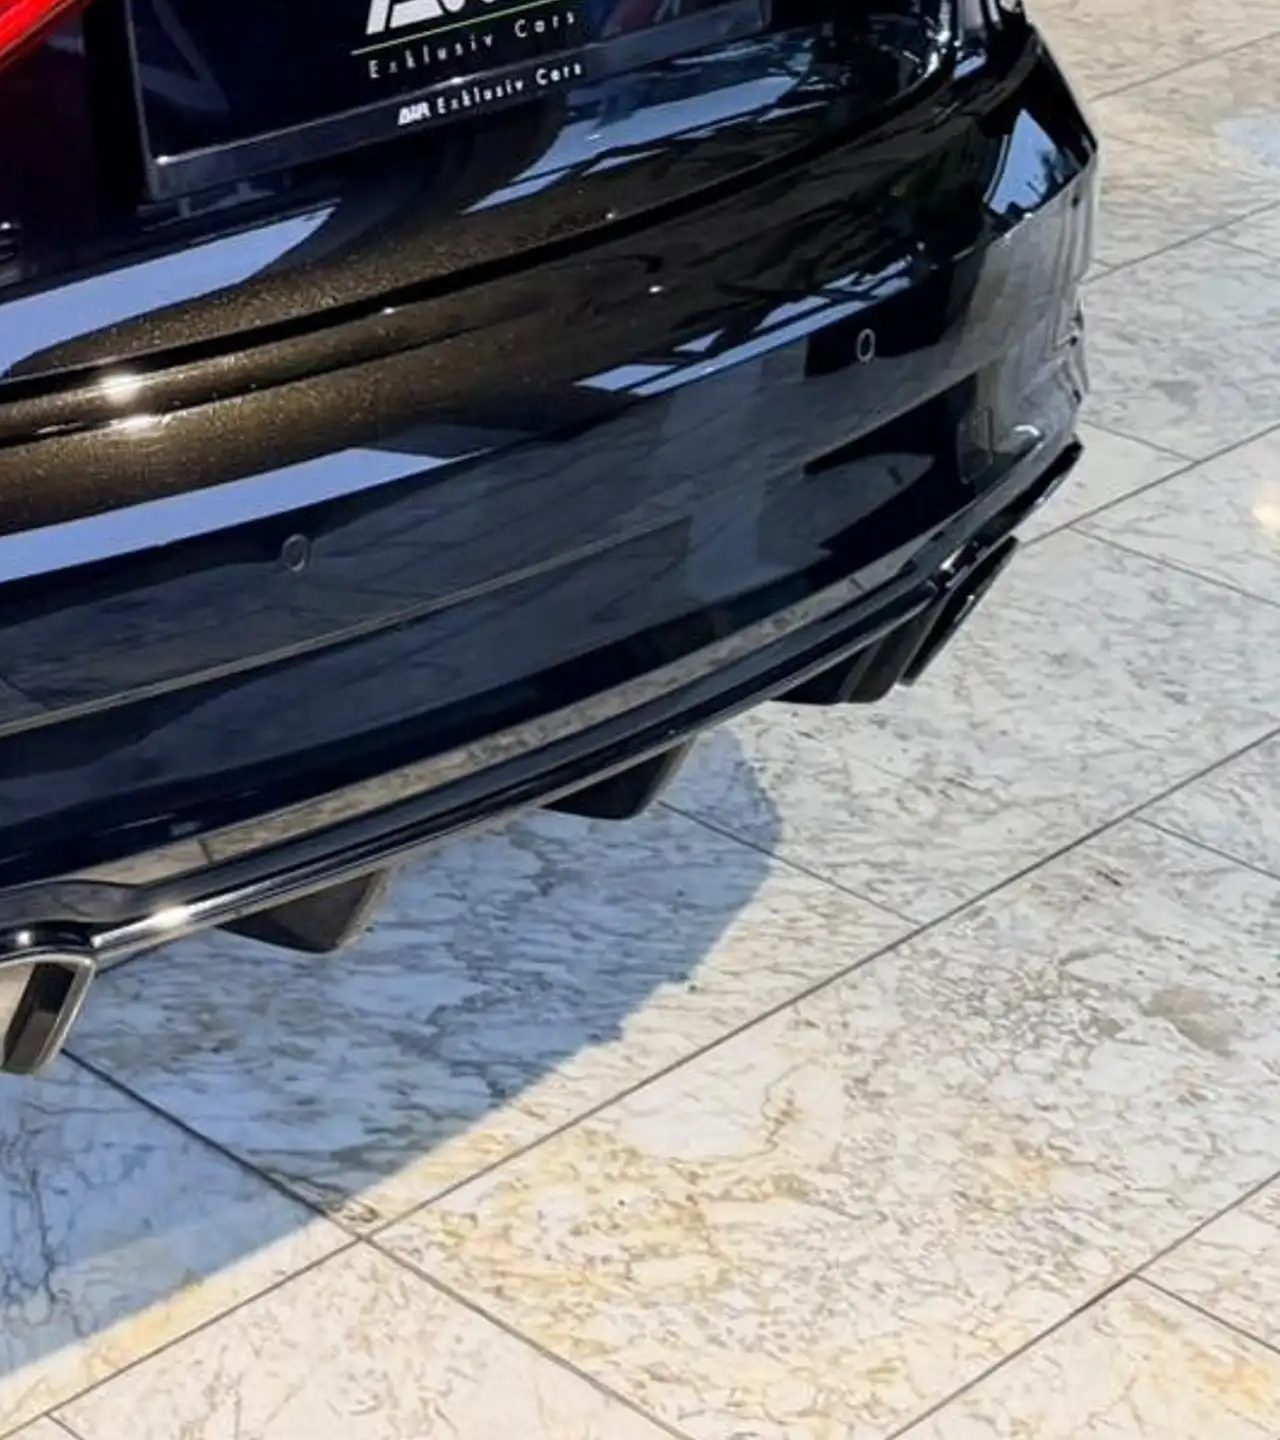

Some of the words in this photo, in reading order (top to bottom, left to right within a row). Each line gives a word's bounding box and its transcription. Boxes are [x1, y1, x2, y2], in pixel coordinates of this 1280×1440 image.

[367, 33, 495, 79] Exklusiv
[513, 10, 576, 39] Cars
[436, 78, 524, 115] Exklusiv
[534, 61, 583, 86] Cars
